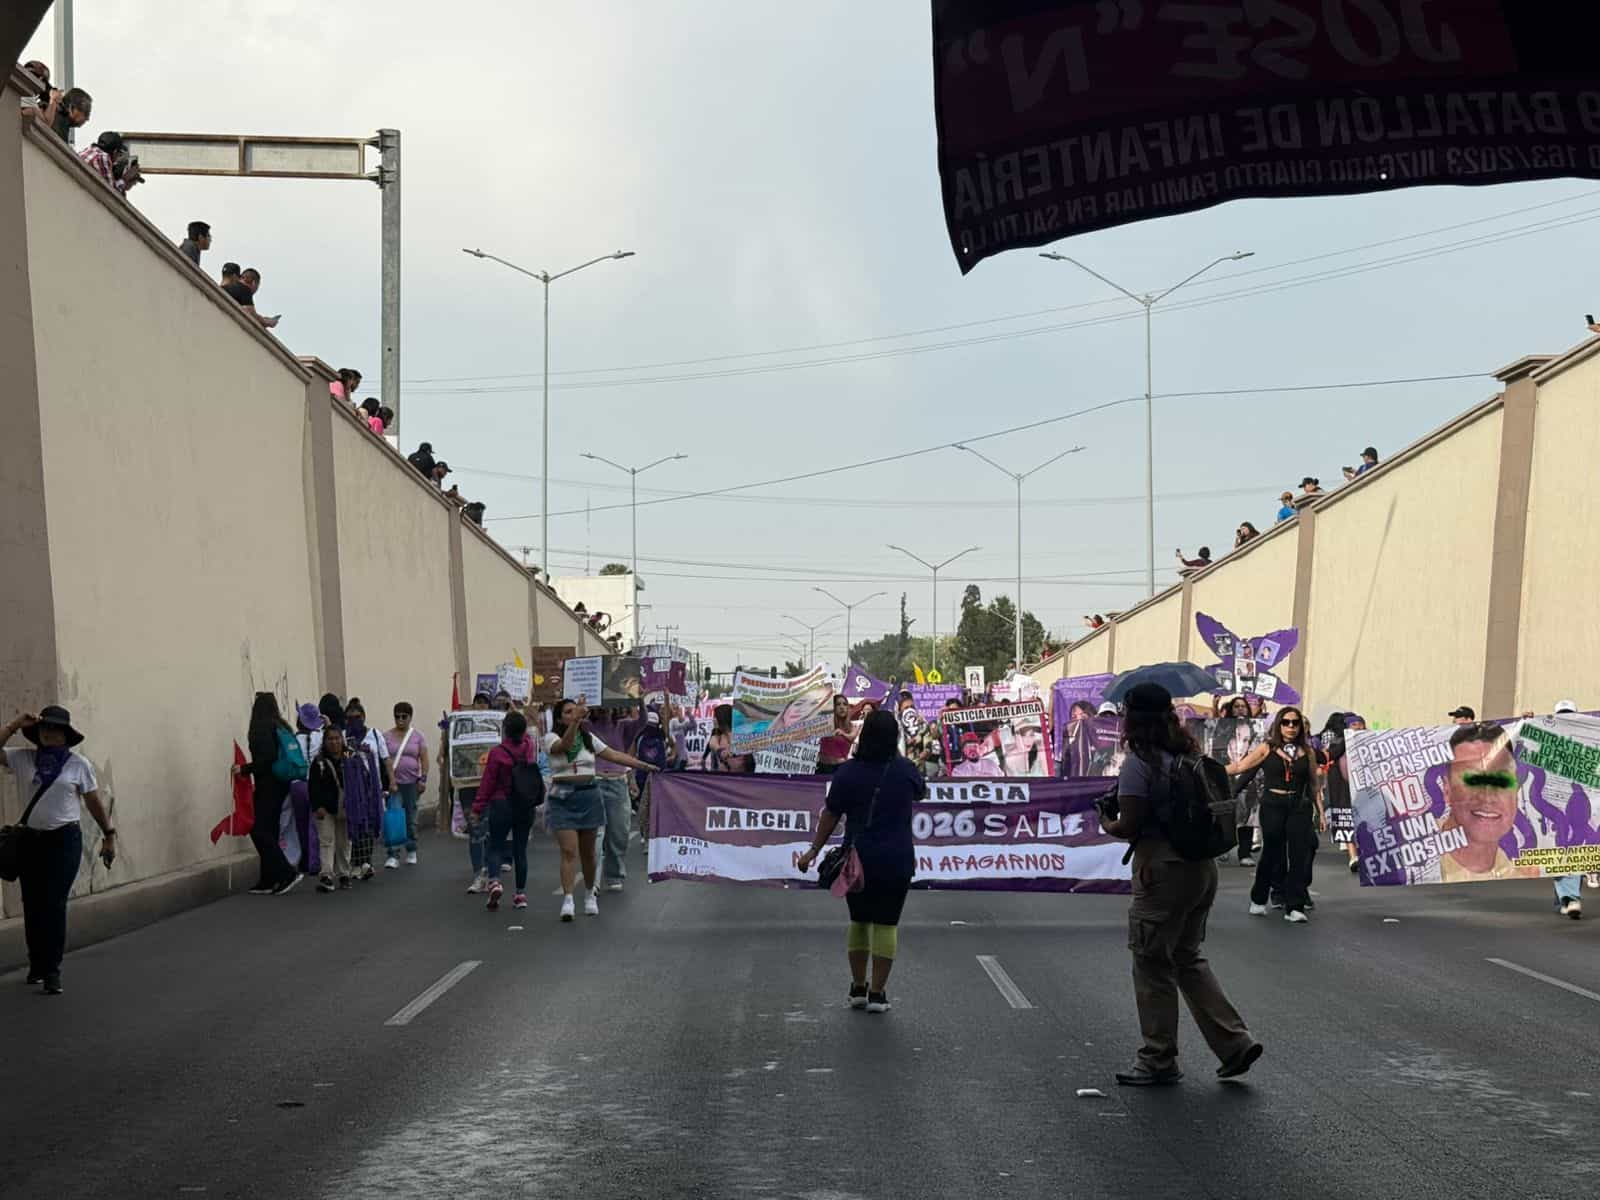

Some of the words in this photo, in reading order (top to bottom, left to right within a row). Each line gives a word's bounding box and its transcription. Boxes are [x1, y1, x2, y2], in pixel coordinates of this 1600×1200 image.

[986, 707, 1010, 719] PARA
[1011, 703, 1042, 716] LAURA
[1358, 728, 1433, 766] PEDIRTE
[1520, 723, 1571, 752] MIENTRAS
[1352, 767, 1377, 792] LA
[1380, 742, 1455, 781] PENSION
[1541, 743, 1552, 758] LO
[1553, 748, 1598, 773] PROTEGE
[1381, 775, 1427, 819] NO
[708, 809, 808, 831] MARCHA
[911, 810, 976, 839] 026
[1373, 826, 1397, 851] ES
[1400, 812, 1440, 842] UNA
[670, 836, 710, 849] MARCHA
[1364, 826, 1469, 878] EXTORSION
[1520, 847, 1566, 857] ROBERTO
[939, 854, 1065, 873] APAGARNOS
[1514, 857, 1555, 867] DEUDOR
[1545, 865, 1577, 874] DESDE
